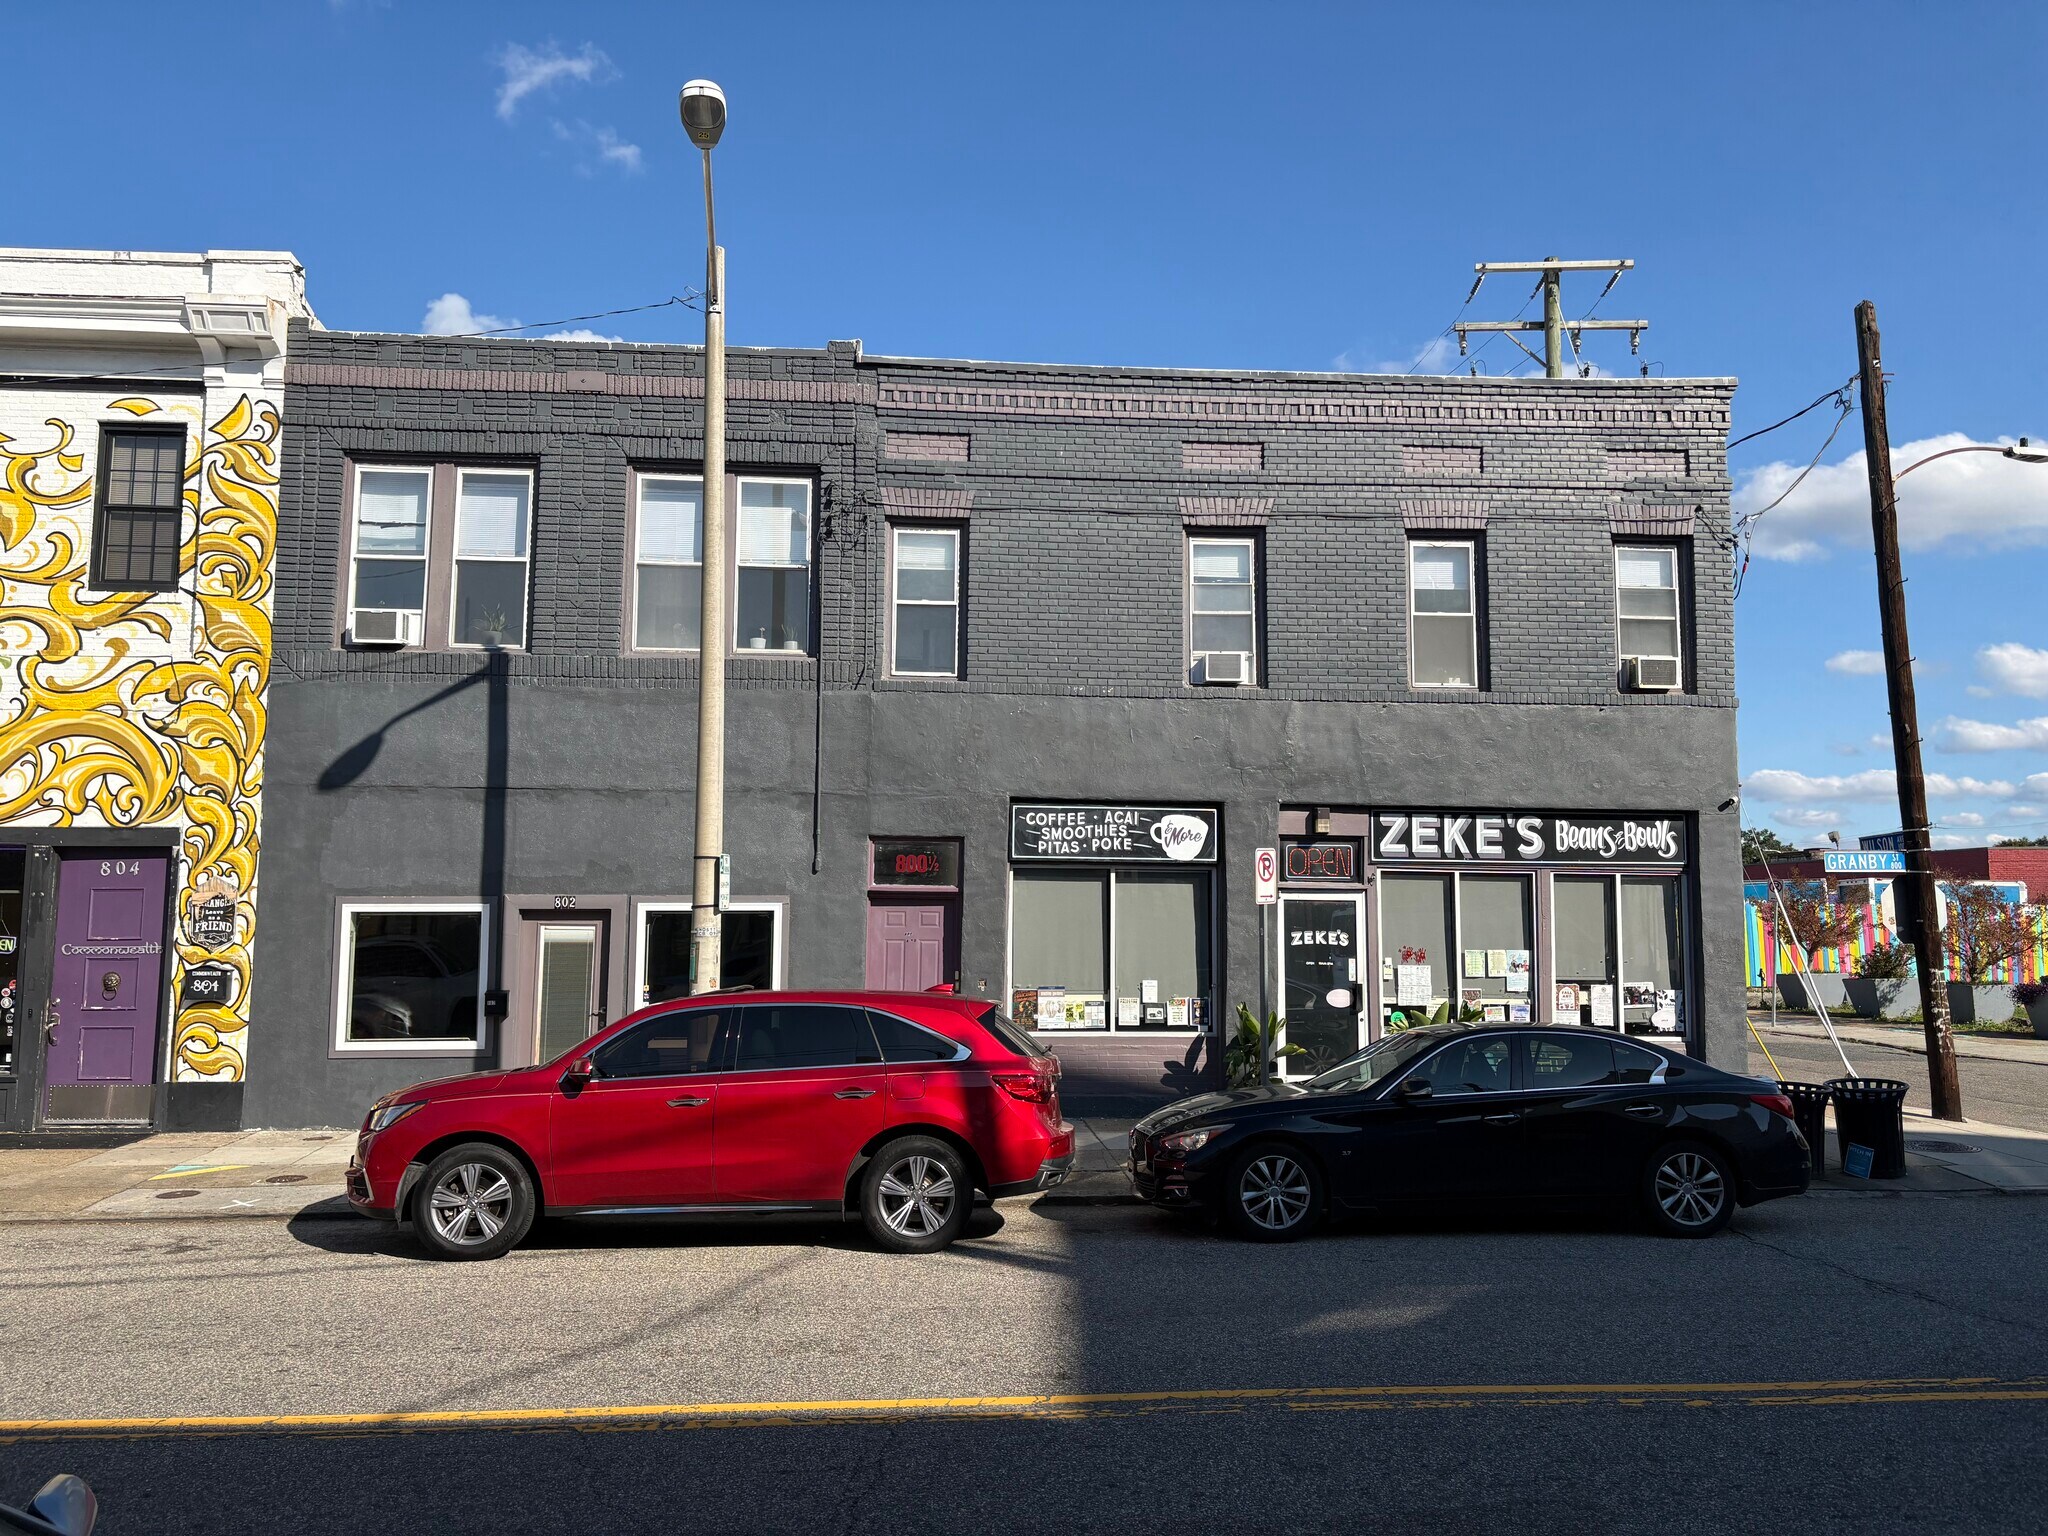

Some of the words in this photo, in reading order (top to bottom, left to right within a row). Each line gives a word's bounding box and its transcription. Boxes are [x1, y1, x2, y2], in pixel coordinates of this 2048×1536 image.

[1025, 812, 1086, 826] COFFEE
[1104, 811, 1140, 825] ACAI
[1041, 825, 1128, 840] SMOOTHIES
[1164, 827, 1202, 848] More
[1380, 813, 1545, 859] ZEKE'S
[1555, 819, 1617, 858] Beans
[1623, 820, 1678, 859] Bowls
[1038, 841, 1080, 854] PITAS
[1092, 838, 1133, 851] POKE
[1861, 837, 1894, 850] WILSON
[100, 861, 140, 876] 804
[1289, 847, 1351, 876] OPEN
[1827, 853, 1887, 870] GRANBY
[554, 896, 576, 908] 802
[194, 920, 233, 933] FRIEND
[1290, 929, 1350, 947] ZEKE'S
[61, 941, 164, 956] Commonwealth
[193, 979, 219, 994] 804
